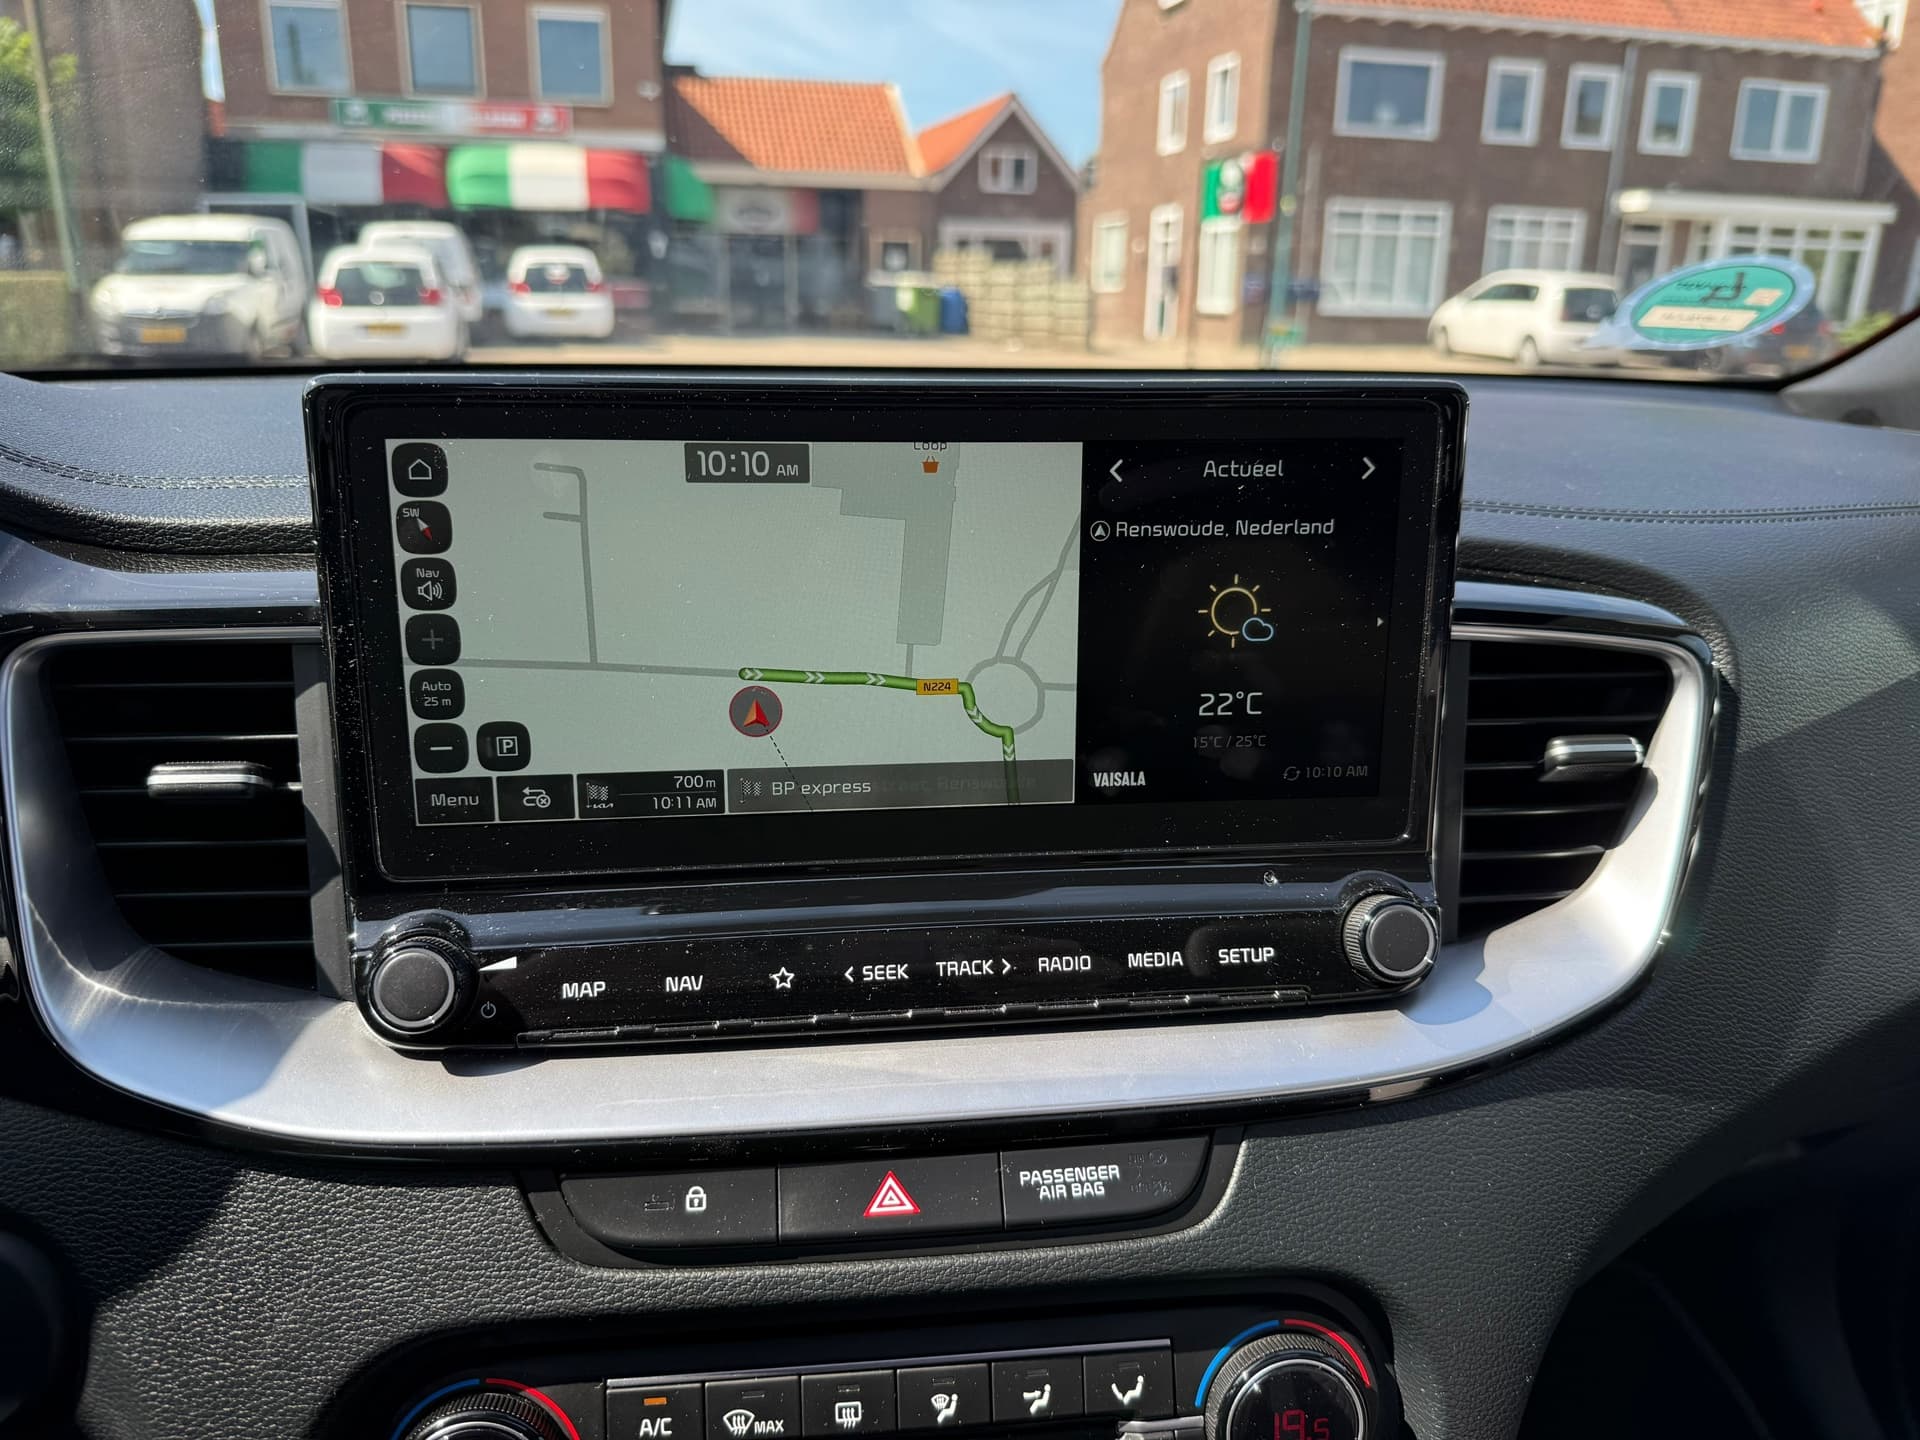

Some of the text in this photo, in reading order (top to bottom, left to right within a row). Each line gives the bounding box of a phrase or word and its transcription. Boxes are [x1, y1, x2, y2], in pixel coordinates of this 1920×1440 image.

[696, 450, 799, 477] 10:10 AM
[1203, 459, 1284, 478] Actueel
[402, 507, 420, 518] SW
[1116, 518, 1334, 538] Renswoude, Nederland
[415, 567, 440, 578] Nav
[421, 681, 452, 692] Auto
[923, 681, 951, 692] N224
[423, 696, 452, 707] 25 m
[1198, 690, 1263, 716] 22°C
[1235, 734, 1267, 748] 25°C
[1093, 771, 1146, 788] VAISALA
[1306, 765, 1368, 779] 10:10 AM
[673, 775, 716, 789] 700 m
[771, 781, 795, 796] BP
[801, 782, 872, 797] express
[431, 793, 480, 807] Menu
[653, 795, 717, 810] 10:11 AM
[1038, 955, 1092, 973] RADIO
[1127, 951, 1184, 969] MEDIA
[1218, 946, 1275, 964] SETUP
[862, 963, 909, 981] SEEK
[935, 959, 994, 977] TRACK
[562, 980, 606, 999] MAP
[665, 974, 704, 993] NAV
[1019, 1164, 1120, 1186] PASSENGER
[1039, 1181, 1105, 1201] AIR BAG
[639, 1417, 673, 1437] A/C
[754, 1419, 785, 1434] MAX
